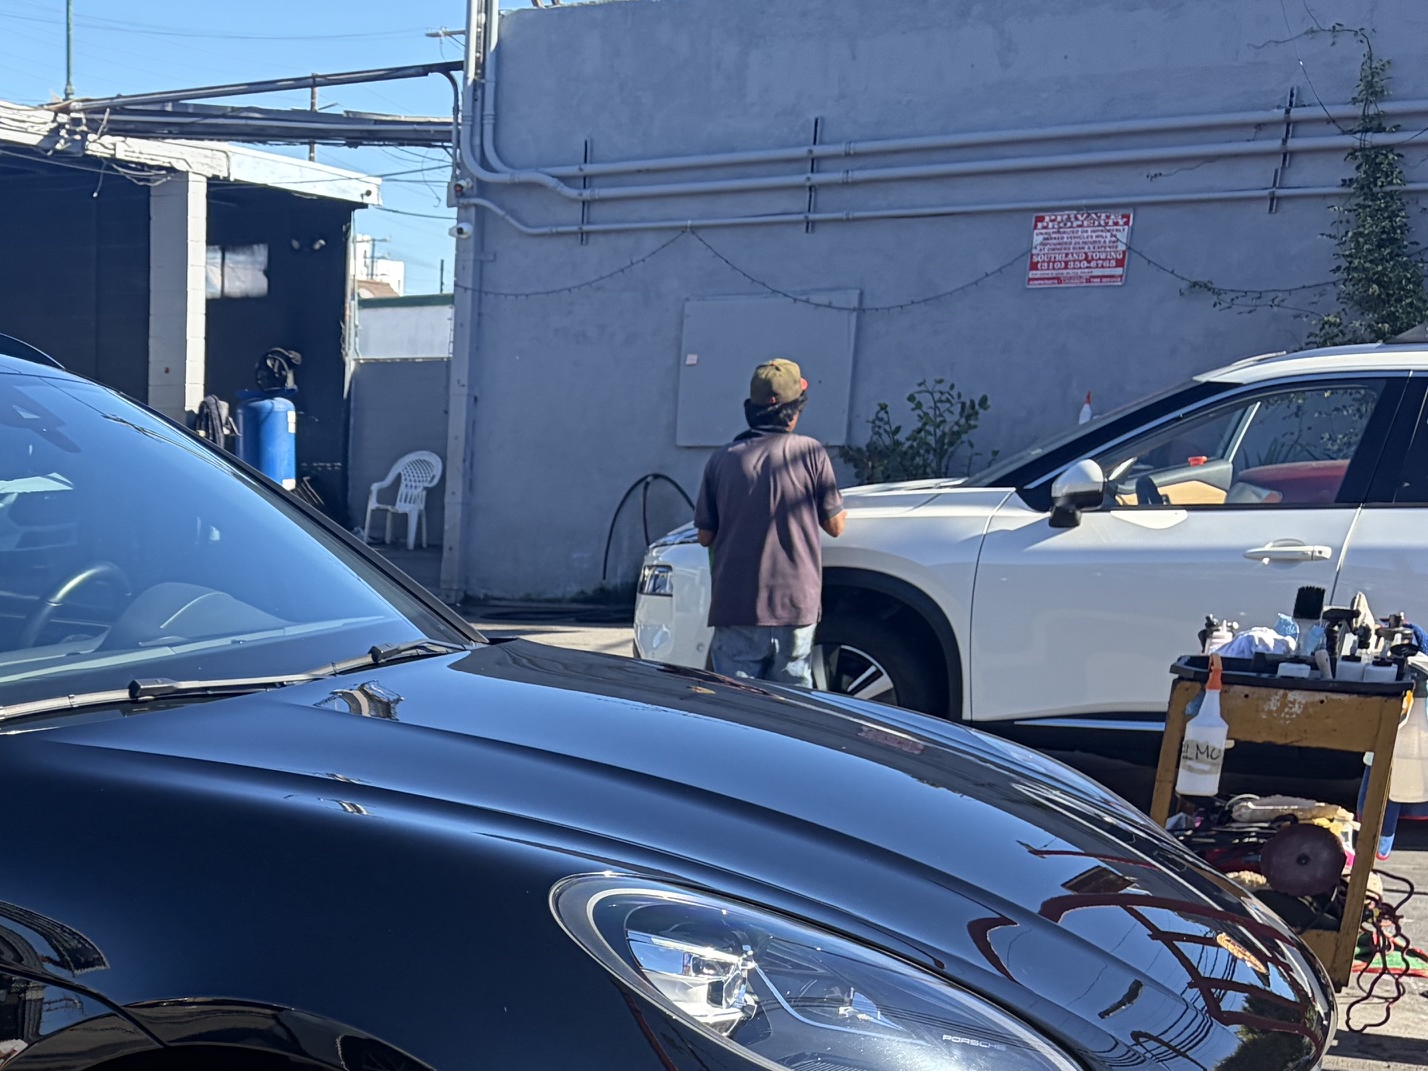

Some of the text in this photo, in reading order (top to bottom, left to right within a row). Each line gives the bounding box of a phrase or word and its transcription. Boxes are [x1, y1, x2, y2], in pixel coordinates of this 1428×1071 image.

[1044, 212, 1122, 222] PRIVATE
[1036, 219, 1127, 229] PROPERTY
[1032, 251, 1123, 262] SOUTHLAND TOWING
[1037, 261, 1064, 270] (310)
[942, 1034, 1006, 1051] PORSCHE
